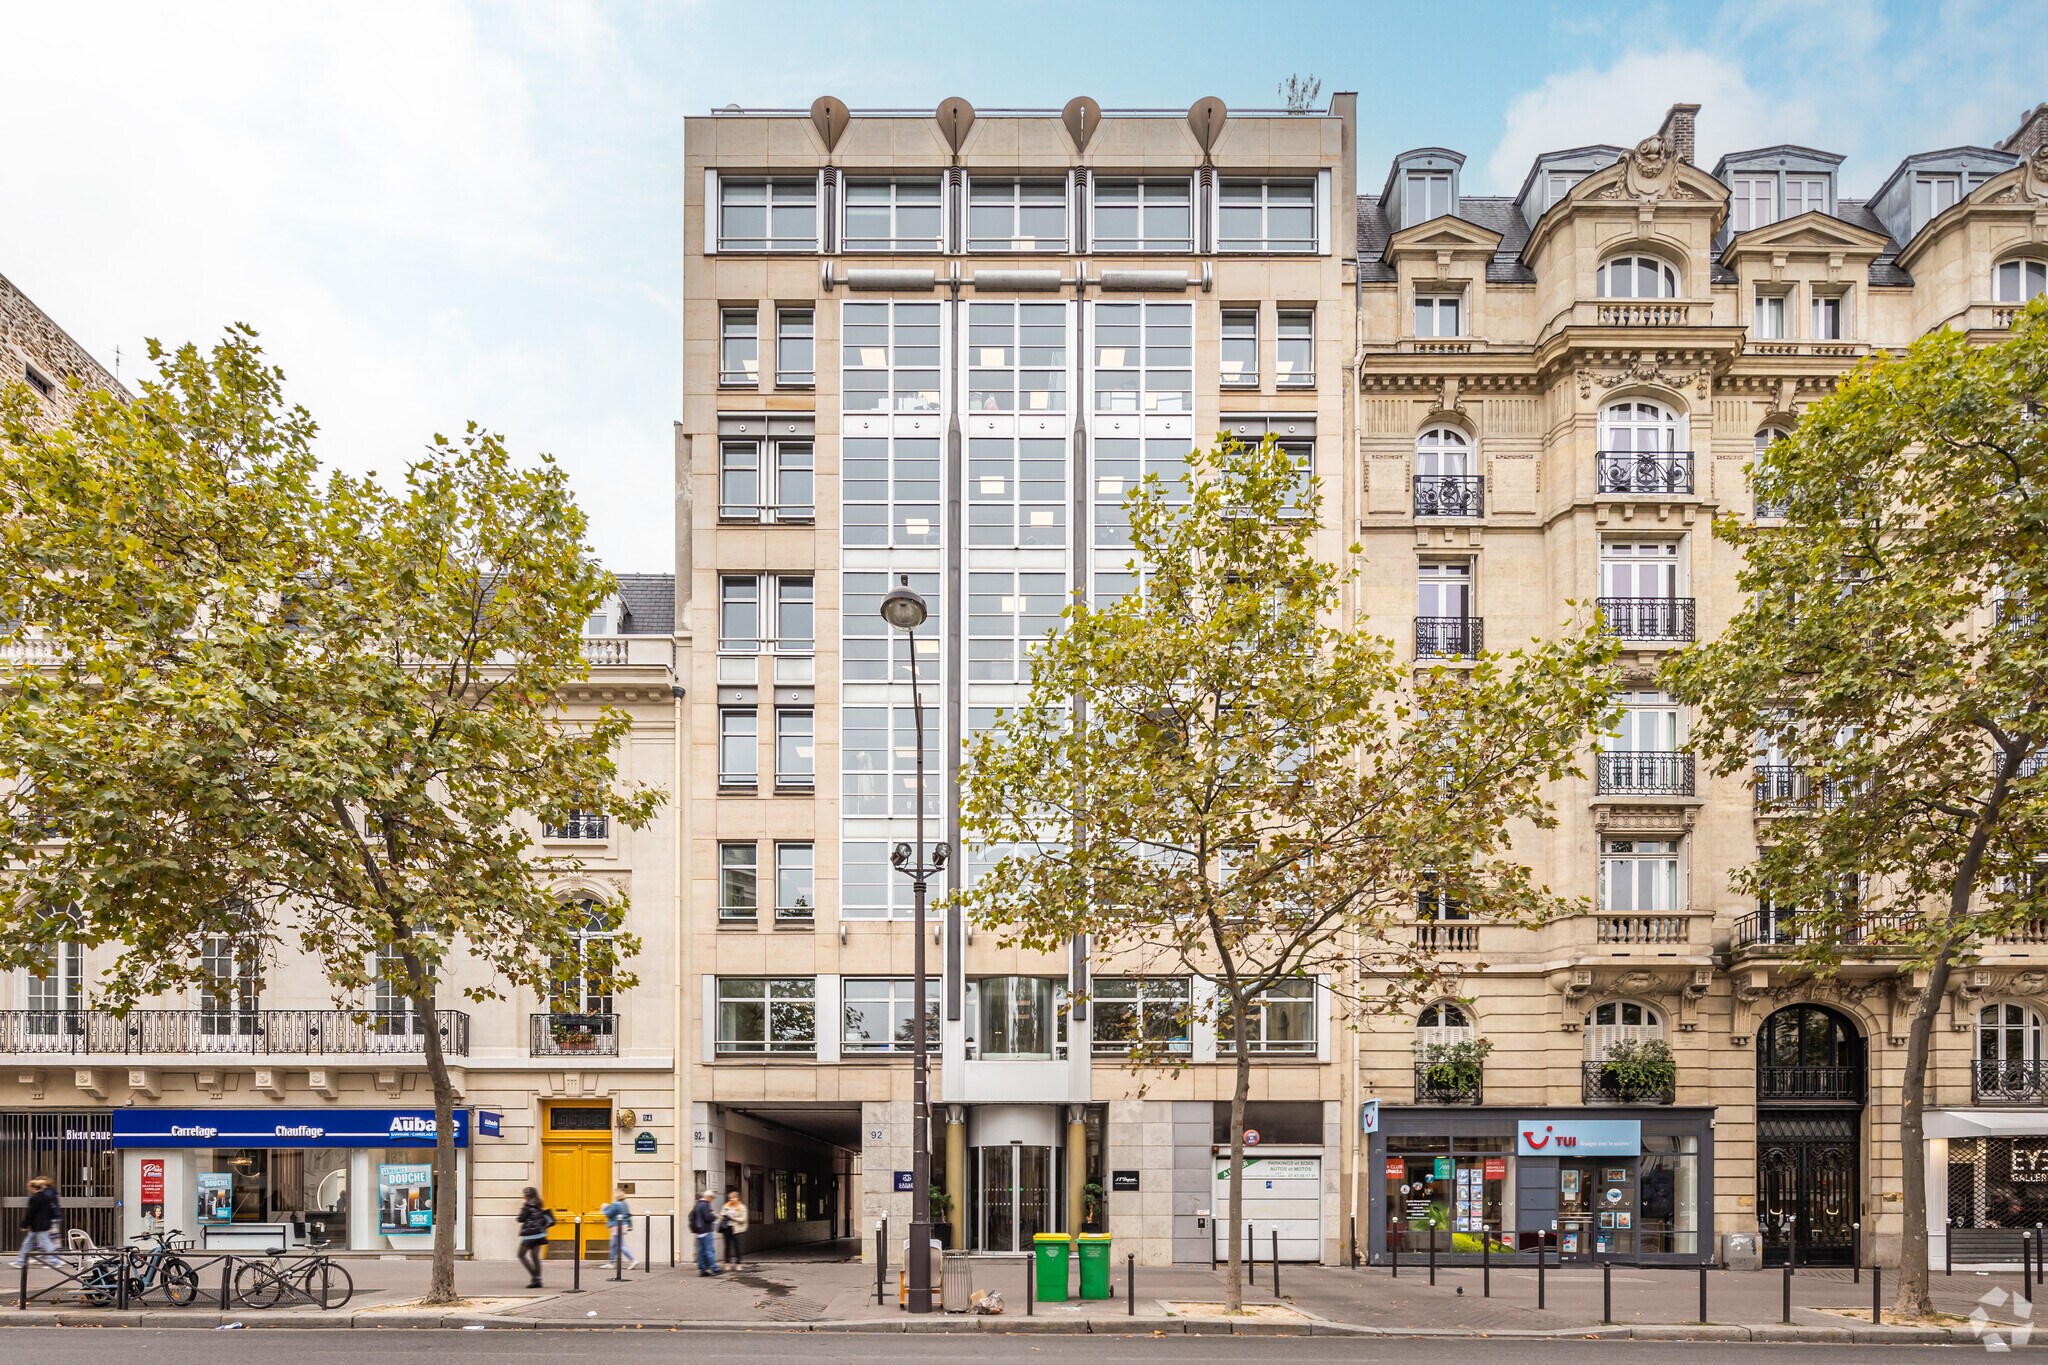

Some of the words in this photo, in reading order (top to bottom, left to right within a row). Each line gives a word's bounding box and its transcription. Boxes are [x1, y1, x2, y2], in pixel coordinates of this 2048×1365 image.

[389, 1117, 460, 1132] Aubae
[171, 1125, 217, 1138] Carrelage
[275, 1125, 323, 1138] Chauffage
[694, 1131, 702, 1140] 92
[871, 1131, 882, 1139] 92
[1555, 1136, 1577, 1147] TUI
[388, 1172, 426, 1184] DOUCHE
[2011, 1173, 2048, 1182] GALLER
[411, 1214, 428, 1222] 350€
